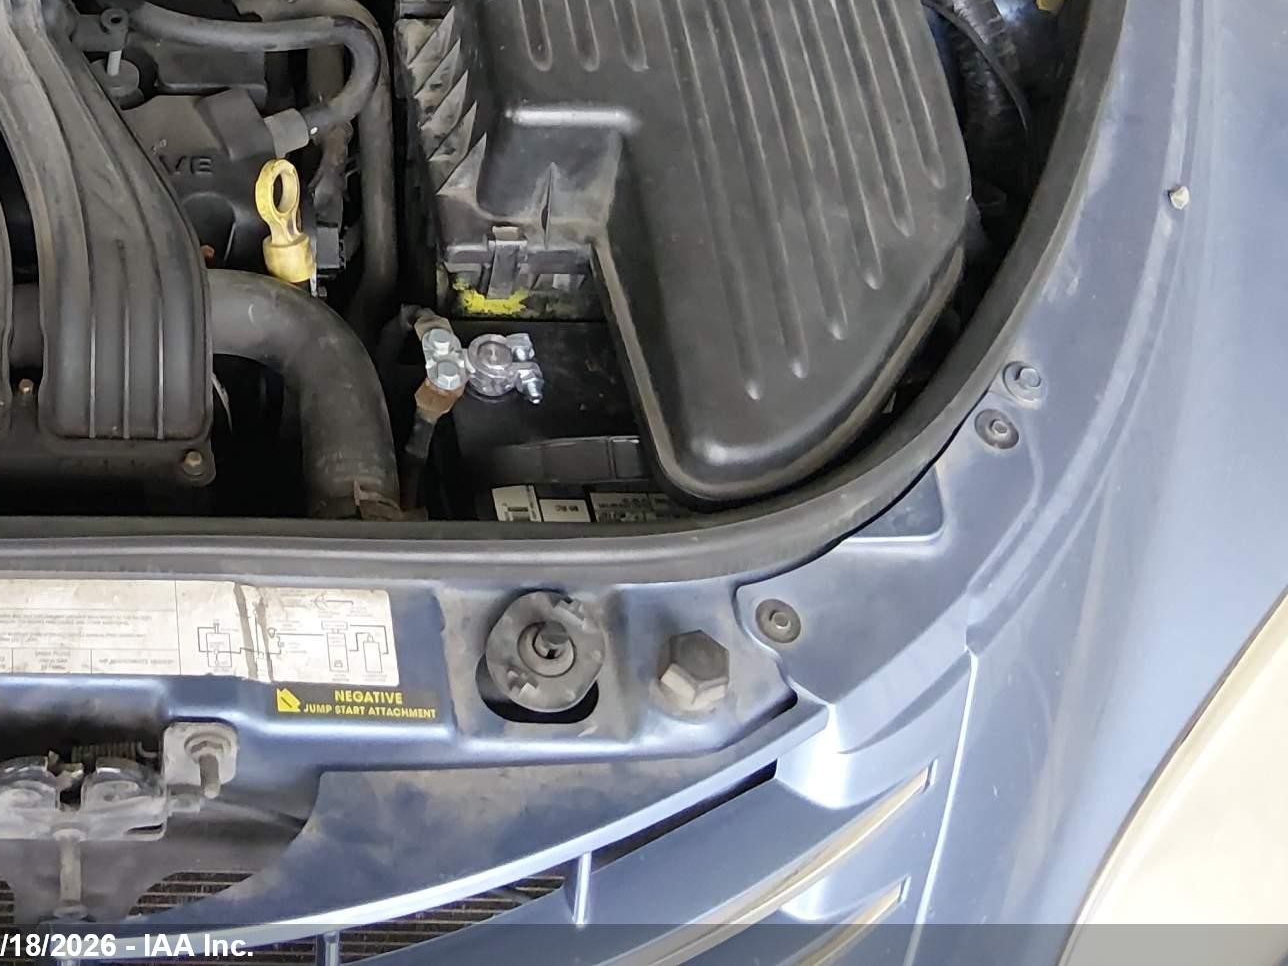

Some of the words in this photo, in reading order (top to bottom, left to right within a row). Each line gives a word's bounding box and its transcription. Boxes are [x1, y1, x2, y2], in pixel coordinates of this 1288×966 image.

[159, 155, 213, 175] VE
[334, 689, 403, 705] NEGATIVE
[303, 704, 332, 714] JUMP
[335, 705, 365, 715] START
[369, 706, 436, 719] ATTACHMENT
